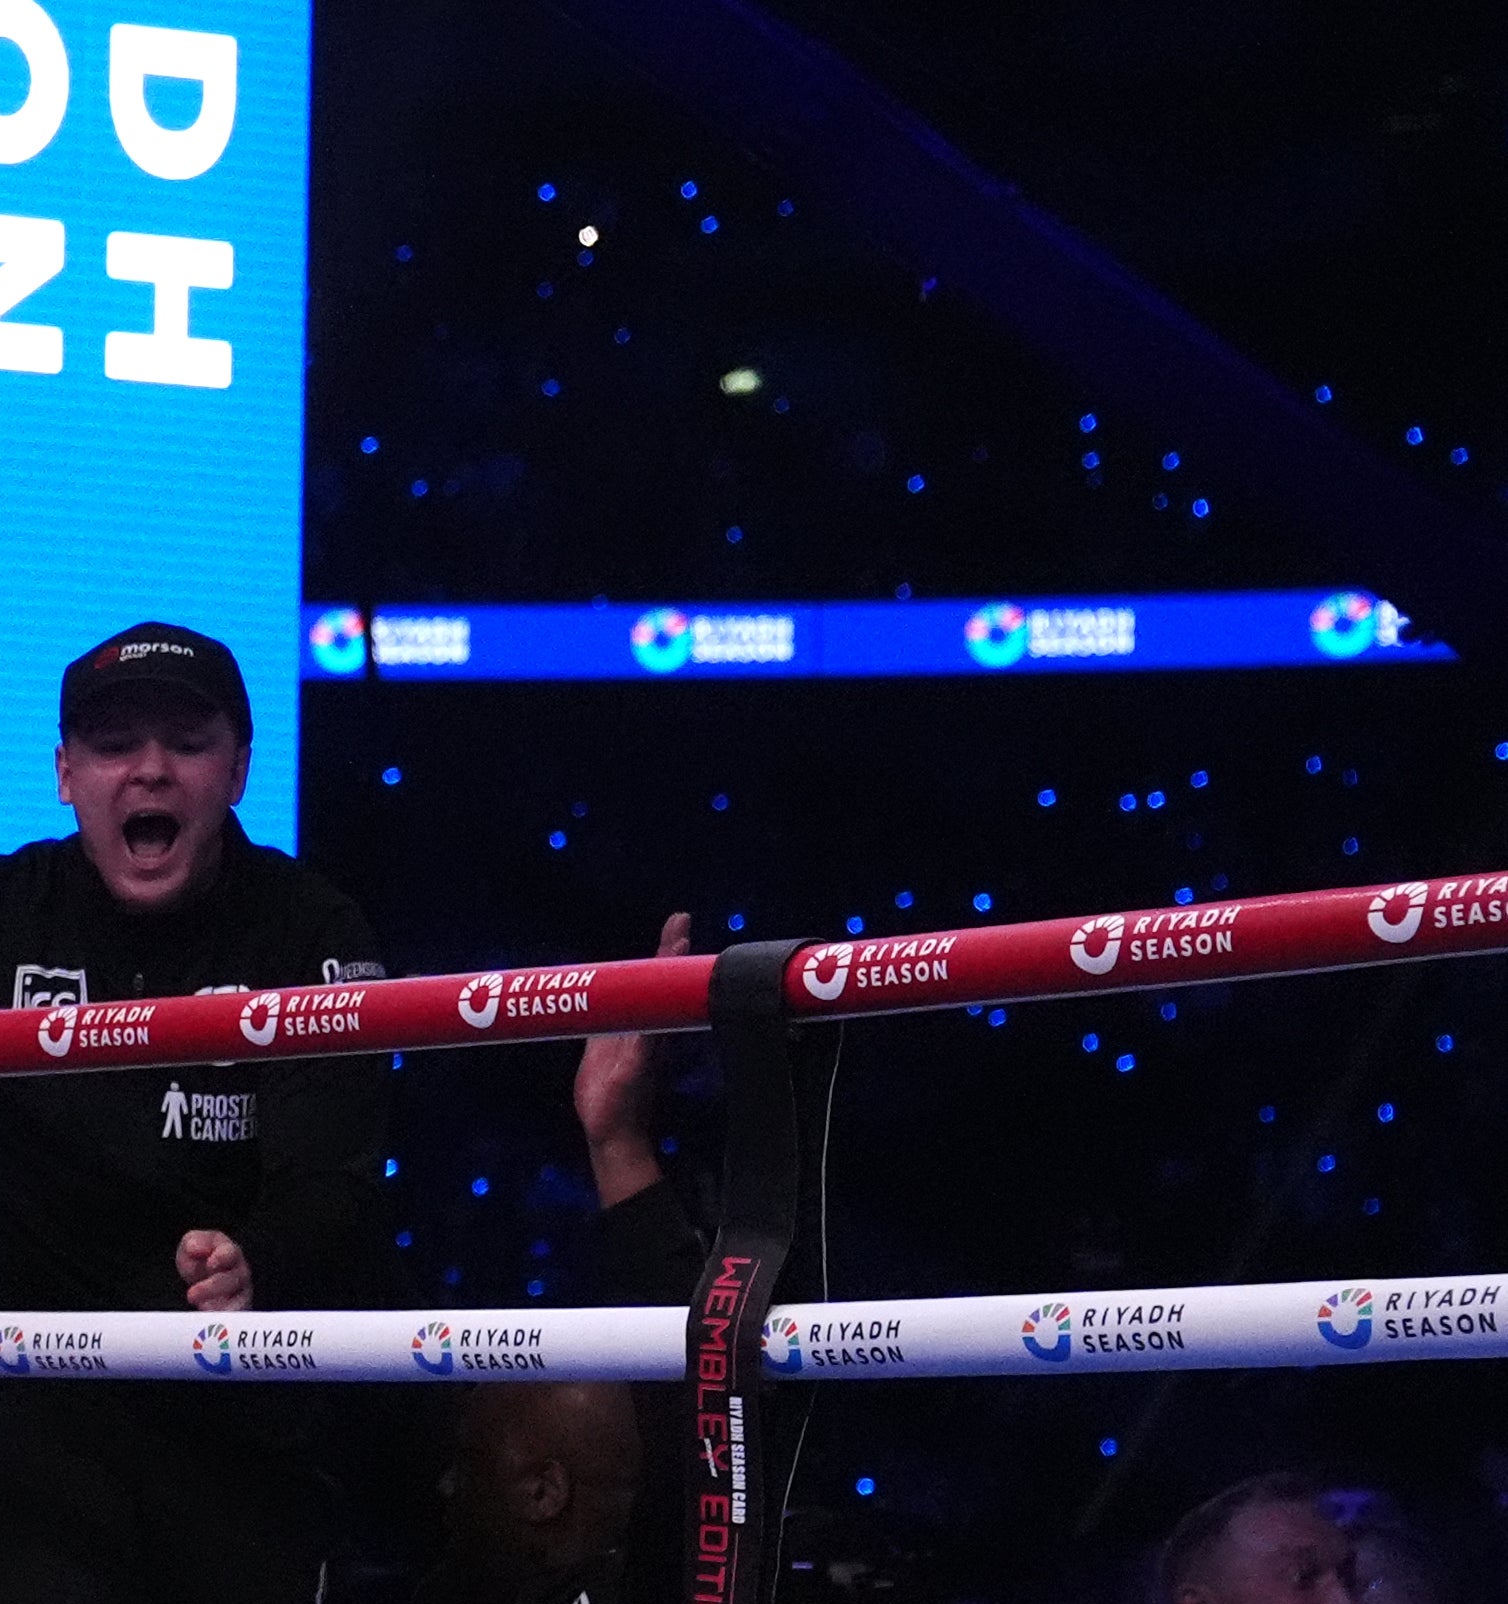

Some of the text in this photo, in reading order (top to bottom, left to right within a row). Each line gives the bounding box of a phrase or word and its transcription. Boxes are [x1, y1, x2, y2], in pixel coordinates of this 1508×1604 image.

[121, 643, 194, 657] morson
[1134, 905, 1242, 933] RIYADH
[1433, 899, 1508, 929] SEAS
[857, 934, 958, 963] RIYADH
[1130, 930, 1233, 962] SEASON
[508, 968, 597, 993] RIYADH
[856, 959, 948, 988] SEASON
[286, 990, 366, 1013] RIYADH
[506, 991, 588, 1018] SEASON
[81, 1005, 156, 1025] RIYADH
[284, 1012, 360, 1036] SEASON
[78, 1026, 149, 1048] SEASON
[1385, 1285, 1501, 1312] RIYADH
[1082, 1304, 1185, 1328] RIYADH
[1384, 1311, 1497, 1339] SEASON
[32, 1332, 103, 1350] RIYADH
[237, 1329, 314, 1348] RIYADH
[459, 1328, 542, 1347] RIYADH
[809, 1319, 901, 1343] RIYADH
[1082, 1330, 1185, 1354] SEASON
[34, 1354, 107, 1371] SEASON
[238, 1352, 316, 1370] SEASON
[461, 1352, 545, 1370] SEASON
[697, 1256, 751, 1472] WEMBLEY
[811, 1345, 905, 1367] SEASON
